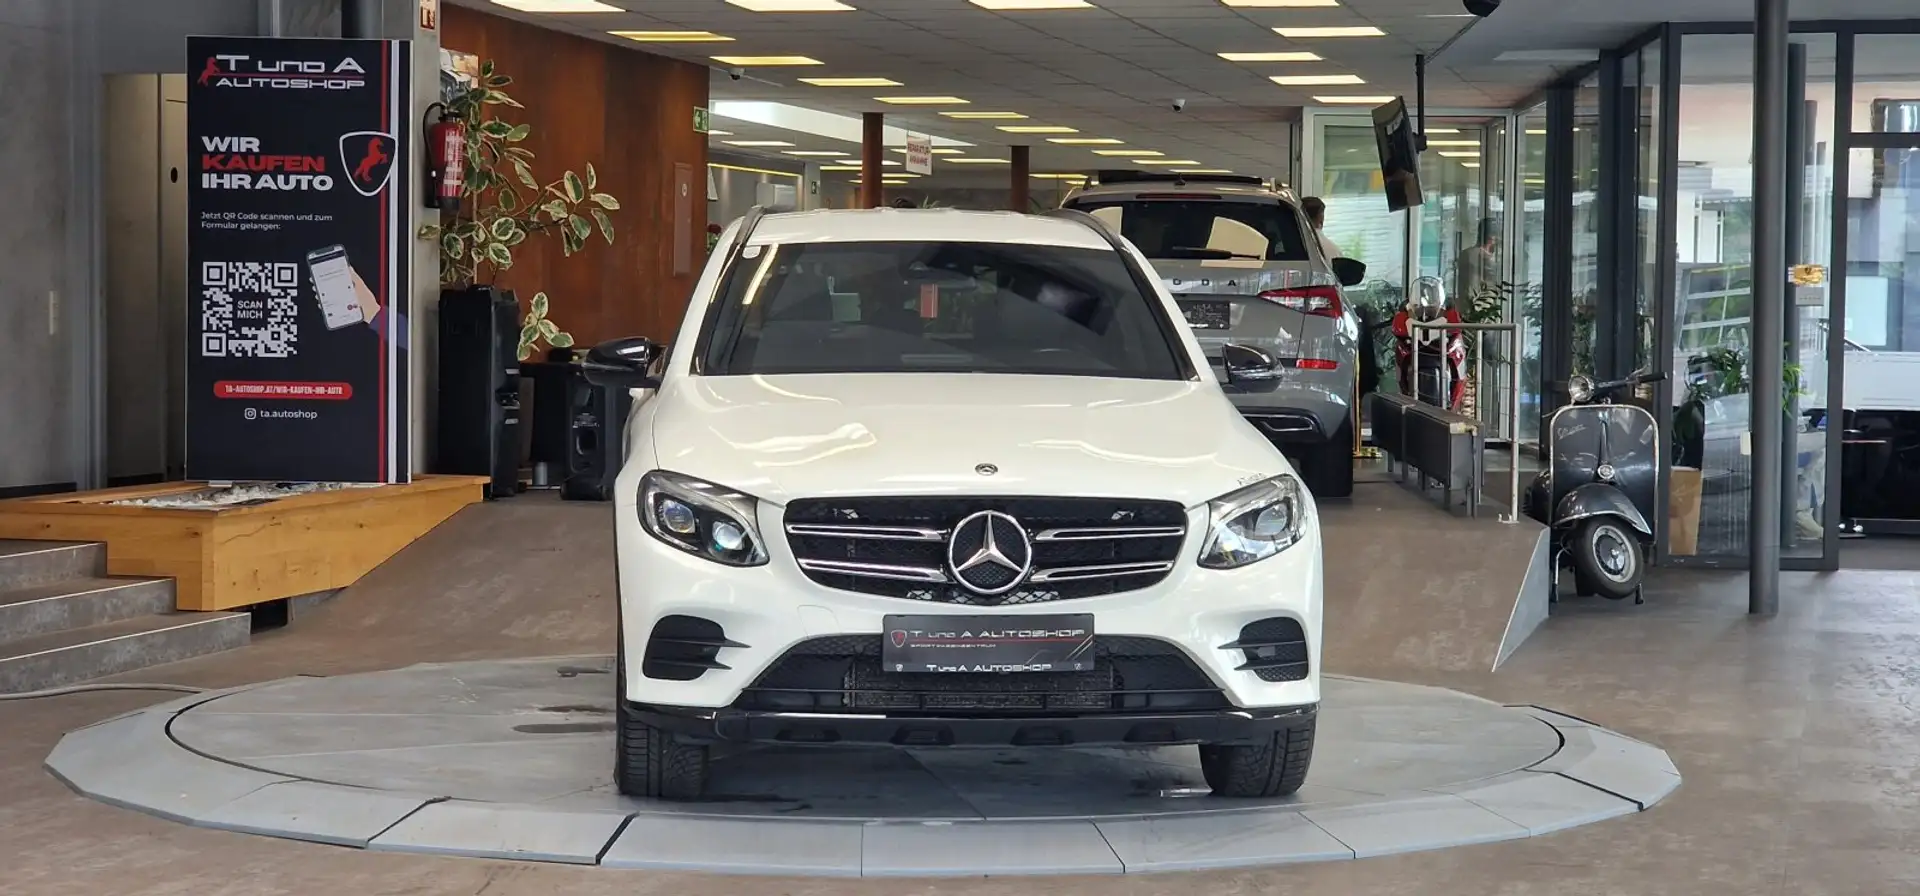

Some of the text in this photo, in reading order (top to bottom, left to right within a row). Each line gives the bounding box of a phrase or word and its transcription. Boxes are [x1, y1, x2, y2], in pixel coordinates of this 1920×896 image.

[216, 54, 250, 71] T
[333, 57, 366, 73] A
[216, 77, 365, 89] AUTOSHOP
[202, 136, 260, 153] WIR
[202, 154, 325, 172] KAUFEN
[202, 173, 334, 191] IHR AUTO
[201, 212, 221, 220] Jetzt
[223, 212, 236, 221] QR
[237, 212, 258, 220] Code
[260, 213, 295, 221] scannen
[296, 213, 312, 221] und
[201, 221, 281, 231] Formular gelangen:
[237, 300, 263, 309] SCAN
[237, 310, 263, 319] MICH
[260, 409, 318, 419] ta.autoshop
[960, 630, 972, 638] A
[979, 629, 1085, 637] AUTOSHOP
[926, 664, 937, 672] T
[956, 664, 968, 672] A
[973, 664, 1052, 672] AUTOSHOP
